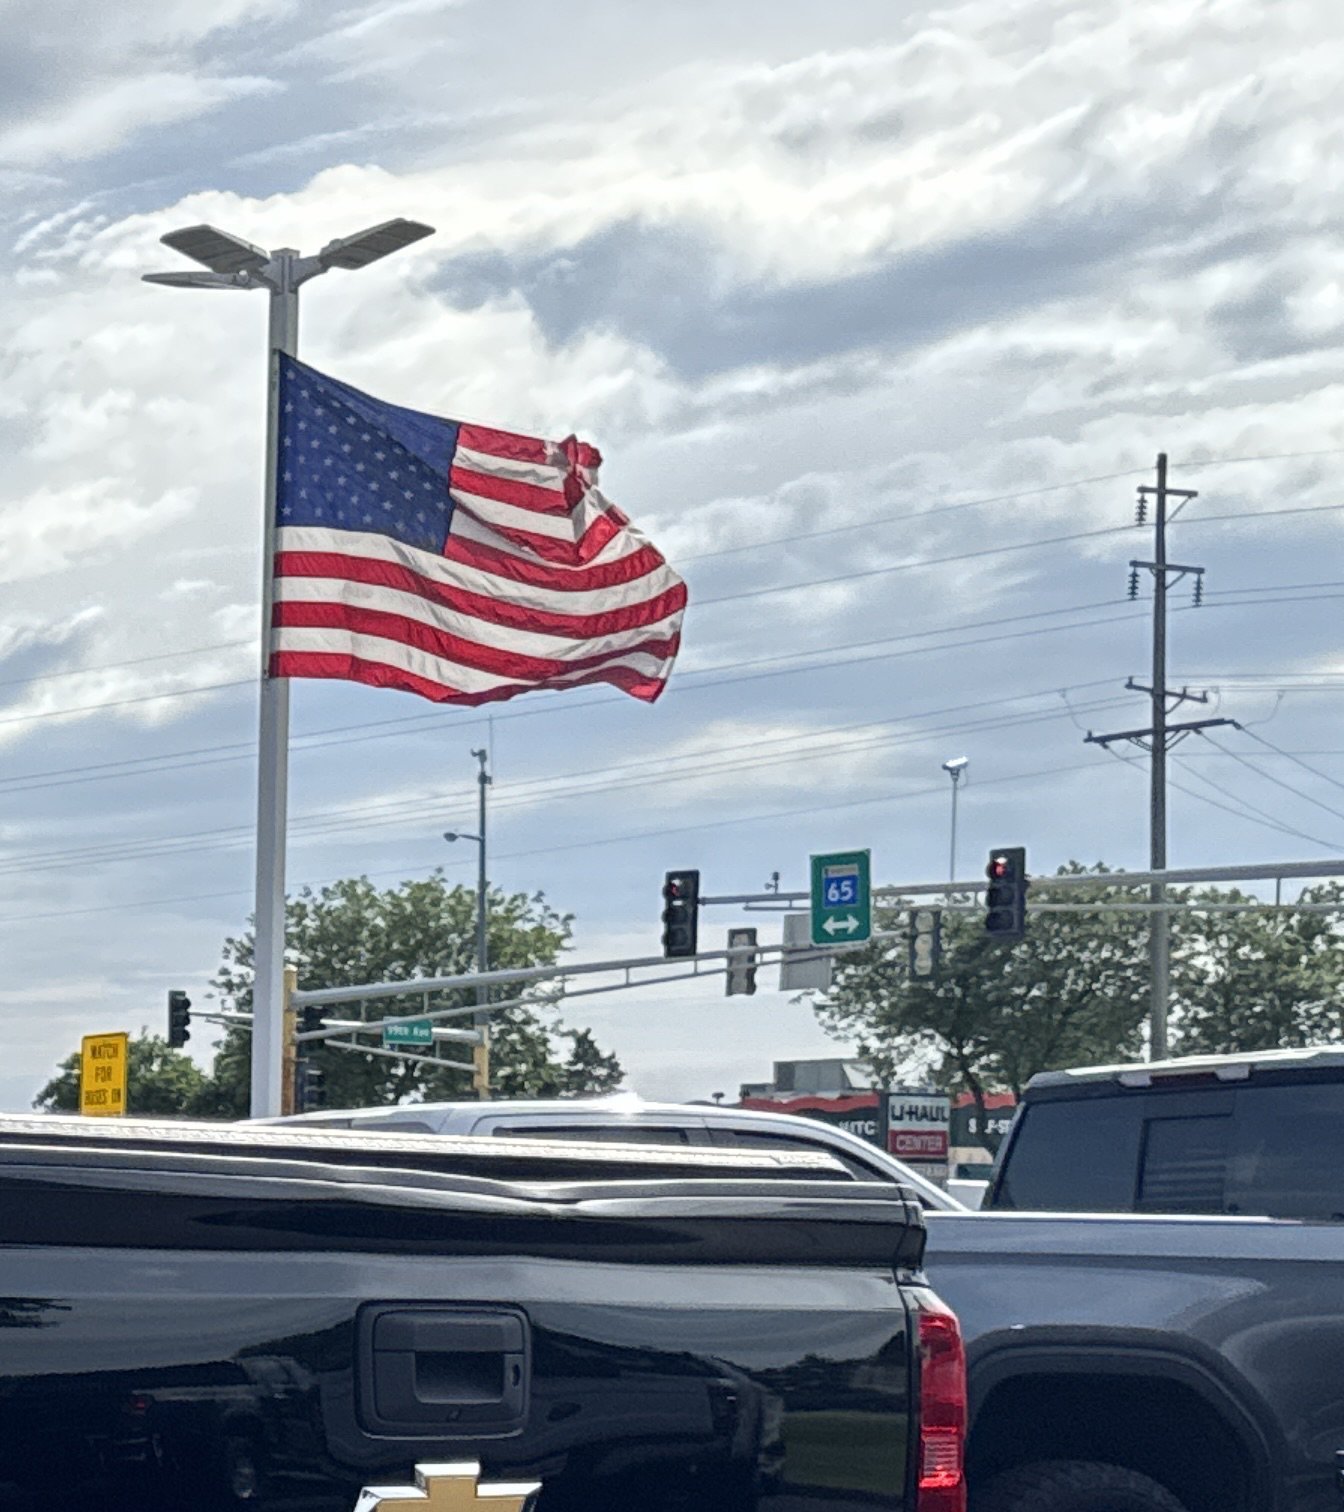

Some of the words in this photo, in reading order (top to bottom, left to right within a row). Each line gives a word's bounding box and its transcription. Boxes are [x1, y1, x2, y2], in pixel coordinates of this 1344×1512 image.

[827, 880, 853, 902] 65
[90, 1043, 119, 1059] WATCH
[94, 1065, 112, 1082] FOR
[891, 1105, 949, 1122] U-HAUL
[896, 1134, 943, 1151] CENTER
